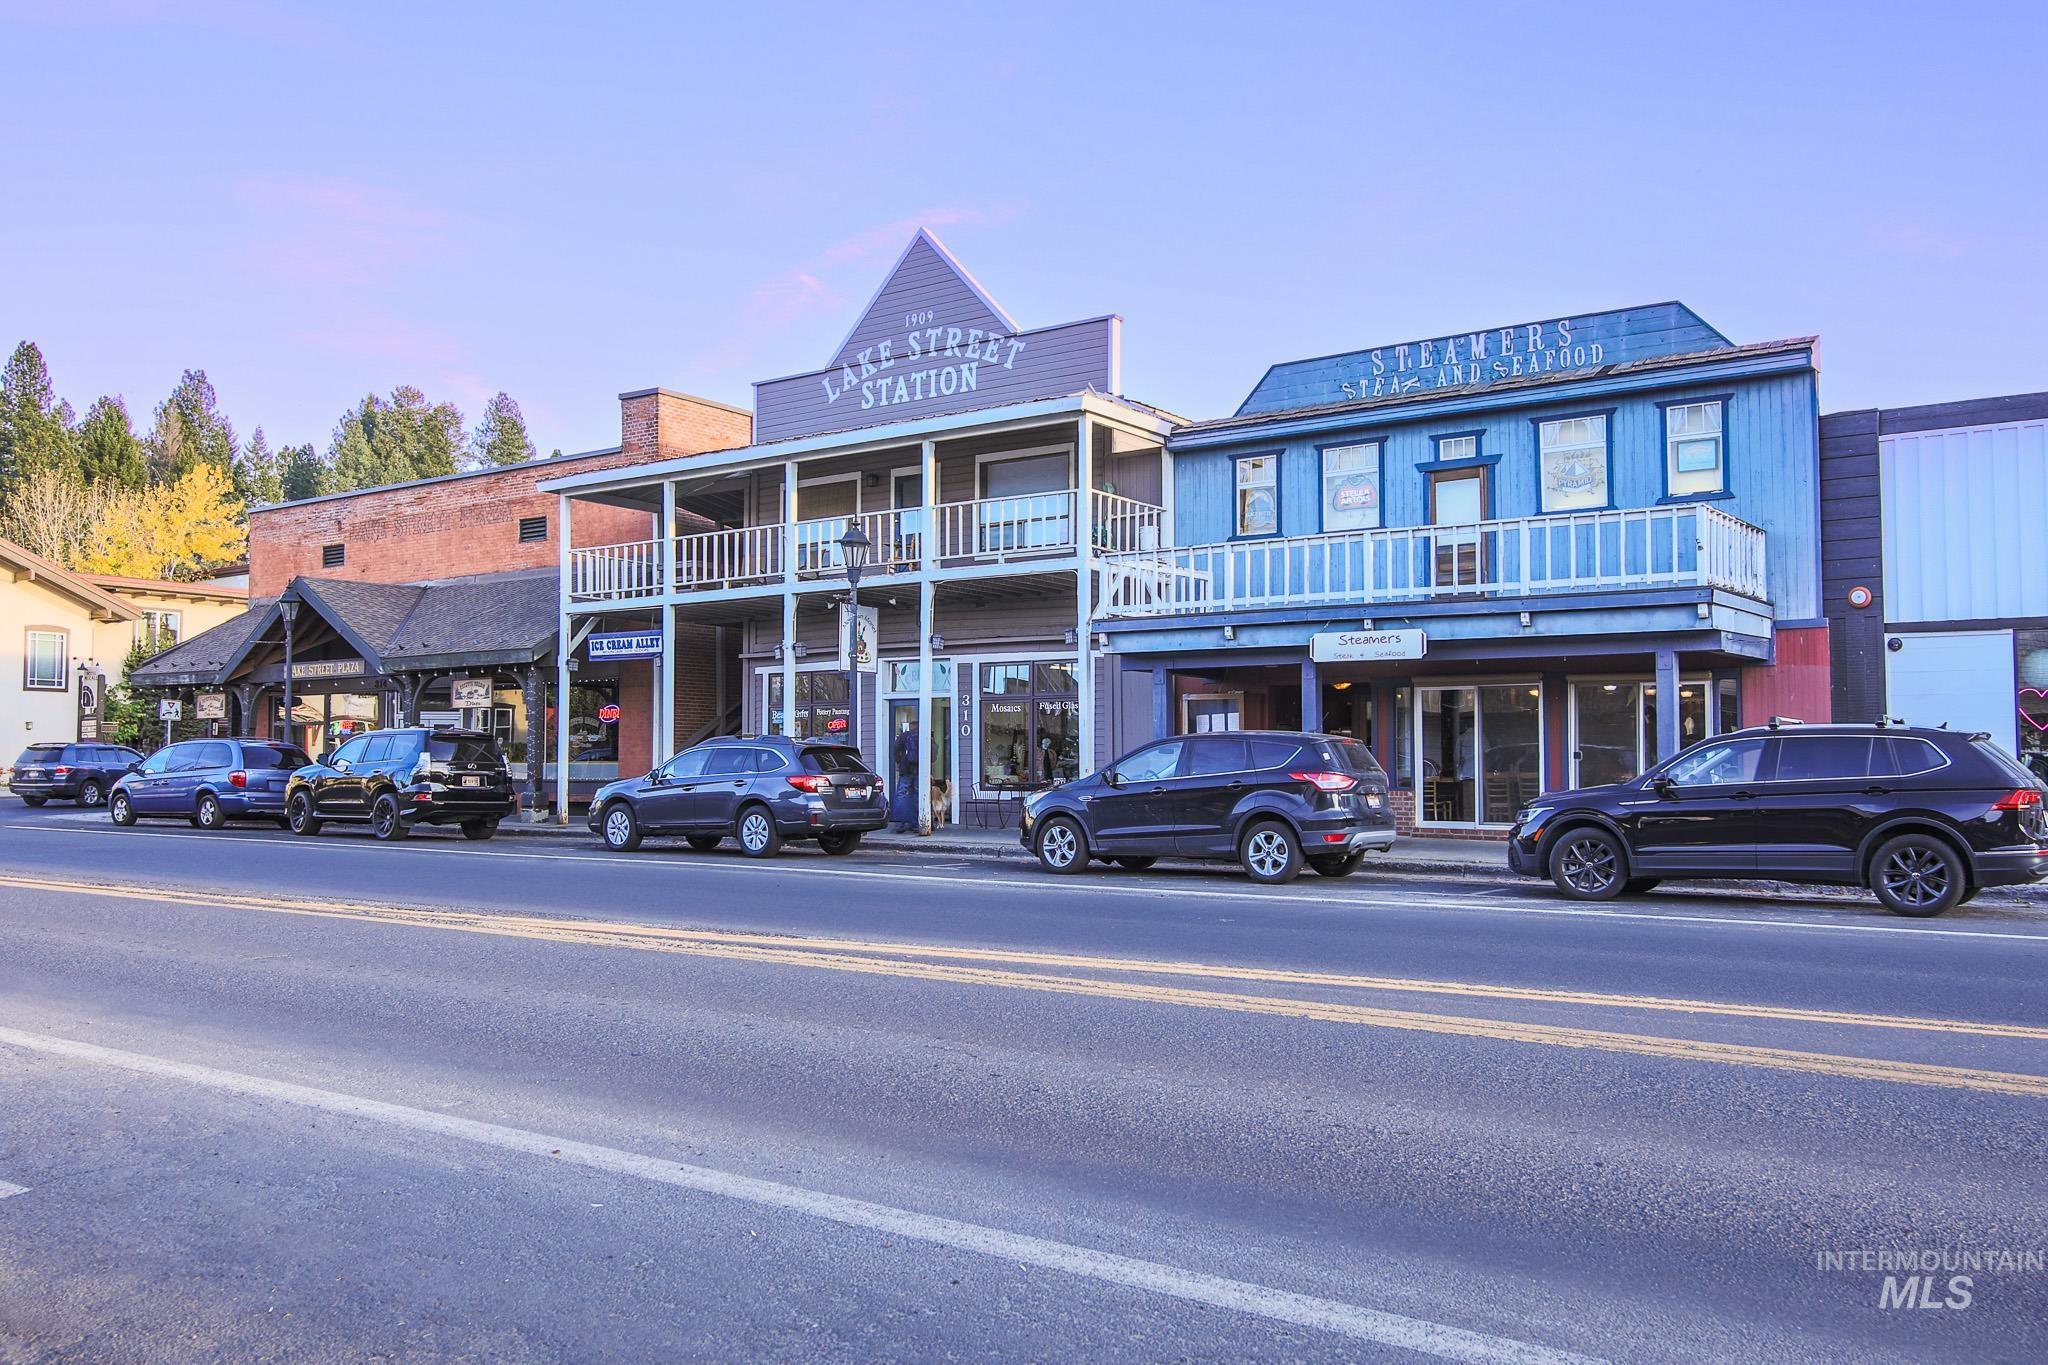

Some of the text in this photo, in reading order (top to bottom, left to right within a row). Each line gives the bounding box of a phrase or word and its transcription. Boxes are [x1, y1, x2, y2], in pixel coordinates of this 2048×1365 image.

[905, 311, 934, 327] 1909
[1371, 319, 1572, 376] STEAMERS
[822, 326, 1026, 404] LAKE STREET
[1341, 343, 1604, 400] STEAK AND SEAFOOD
[861, 361, 979, 409] STATION
[1558, 476, 1594, 488] PYRAMID
[1340, 488, 1370, 498] STELLA
[591, 638, 660, 651] ICE CREAM ALLEY
[1338, 634, 1402, 646] Steamers
[1374, 650, 1406, 658] Seafood
[292, 662, 360, 677] AKE STREET PLAZA
[991, 703, 1022, 713] Mosaics
[1039, 701, 1079, 710] Fused Glas
[795, 709, 809, 718] Gifts
[961, 694, 971, 737] 310
[827, 720, 847, 729] OPEN
